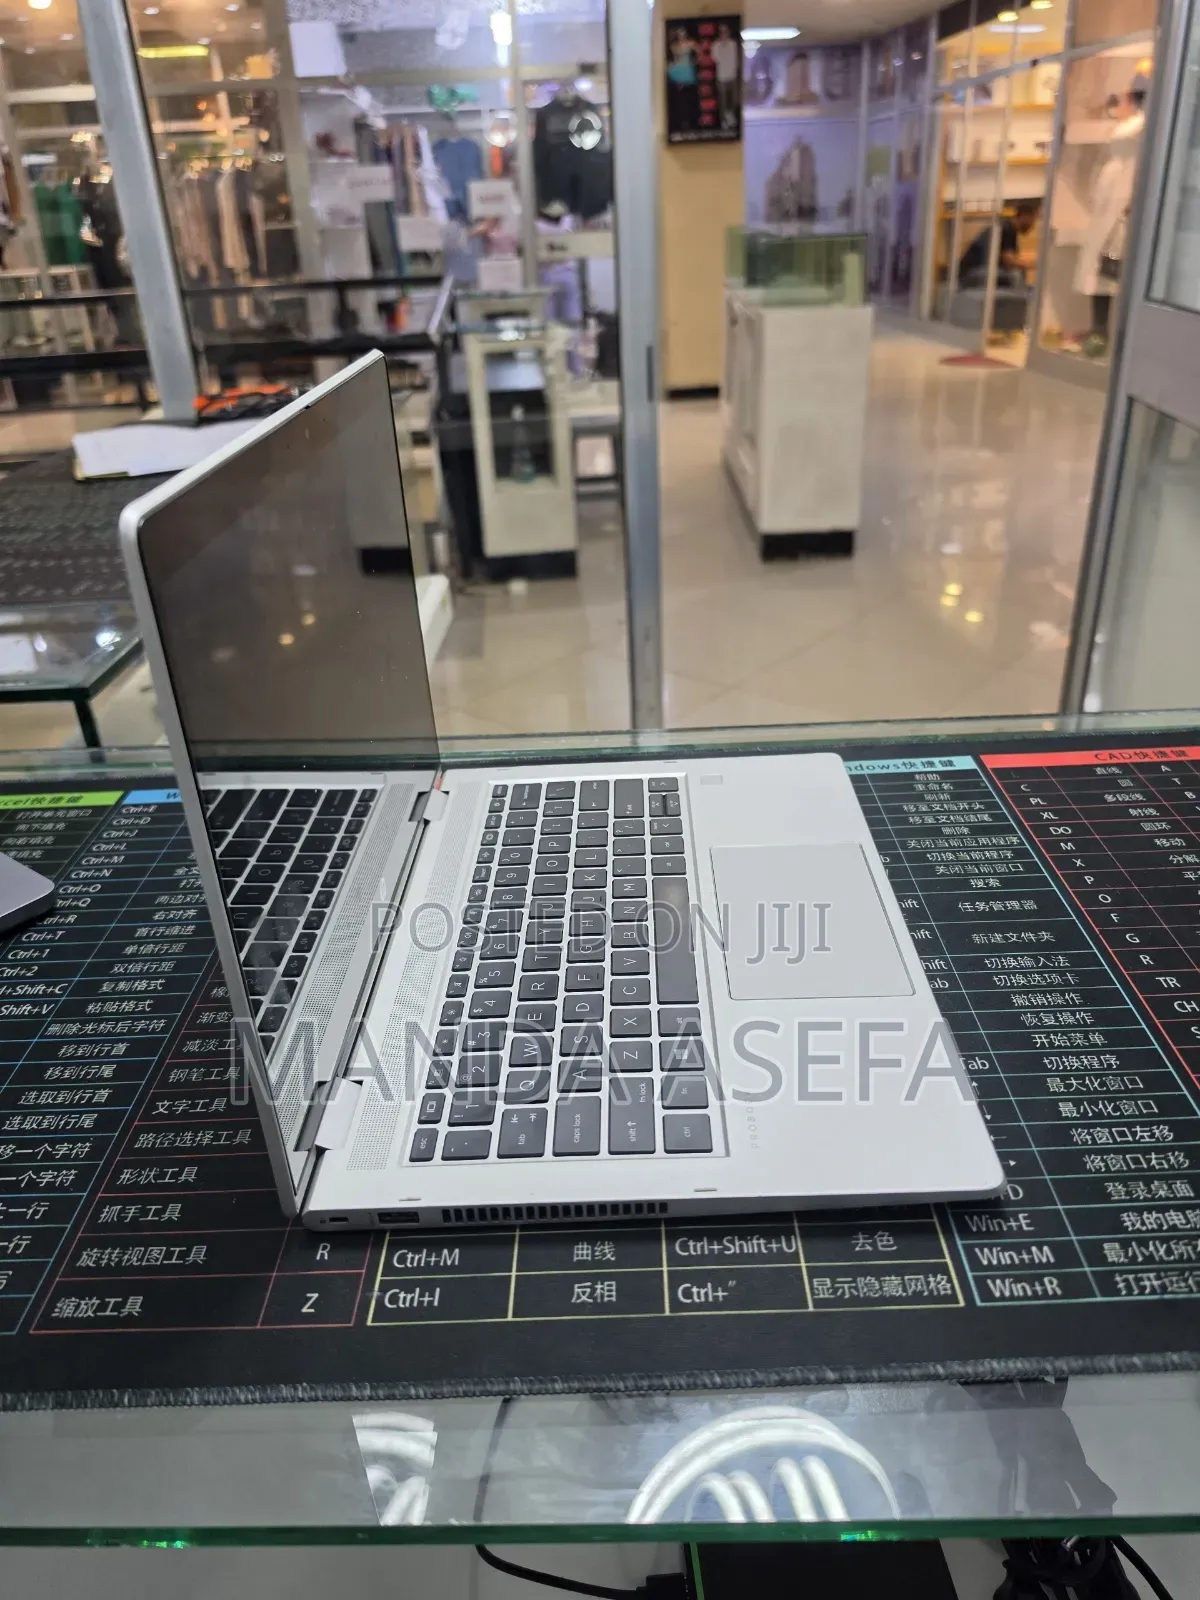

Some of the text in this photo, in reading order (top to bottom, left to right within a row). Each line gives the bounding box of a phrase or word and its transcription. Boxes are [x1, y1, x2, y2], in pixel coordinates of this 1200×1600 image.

[1094, 750, 1189, 761] CAD快捷键
[1160, 765, 1171, 773] A
[1171, 777, 1182, 786] T
[1020, 784, 1031, 792] C
[1029, 797, 1047, 806] PL
[1103, 793, 1146, 803] 多段线
[1184, 791, 1196, 800] B
[903, 801, 985, 812] 移至文档开头
[1040, 811, 1059, 820] XL
[112, 817, 151, 827] Ctrl+D
[1140, 821, 1171, 832] 圆环
[102, 830, 139, 840] Ctrl+J
[1049, 826, 1072, 835] DO
[92, 843, 127, 853] Ctrl+L
[906, 836, 1020, 849] 关闭当前应用程序
[1060, 842, 1076, 851] M
[1154, 837, 1187, 848] 移动
[81, 855, 125, 866] Ctrl+M
[926, 850, 1014, 862] 切换当前程序
[1072, 857, 1085, 867] X
[546, 860, 558, 868] O
[935, 863, 1024, 875] 关闭当前窗口
[71, 869, 113, 880] Ctrl+N
[584, 873, 596, 881] K
[1083, 875, 1094, 885] P
[623, 883, 636, 891] M
[969, 877, 1002, 888] 搜索
[59, 884, 101, 895] Ctrl+O
[1098, 892, 1111, 903] O
[623, 906, 636, 914] N
[958, 899, 1038, 913] 任务管理器
[37, 915, 78, 926] trl+R
[153, 910, 198, 921] 右对齐
[1110, 913, 1121, 924] F
[582, 920, 594, 928] H
[22, 931, 66, 943] Ctrl+T
[135, 926, 196, 937] 首行缩进
[623, 931, 636, 939] B
[971, 931, 1056, 945] 新建文件夹
[1125, 933, 1141, 945] G
[8, 949, 50, 961] Ctrl+1
[123, 943, 186, 955] 单倍行距
[580, 944, 593, 954] G
[534, 954, 549, 962] T
[624, 957, 637, 966] V
[984, 955, 1071, 969] 切换输入法
[1139, 954, 1155, 967] R
[110, 961, 177, 974] 双倍行距
[488, 970, 501, 978] 5
[577, 973, 592, 981] F
[992, 972, 1080, 986] 切换选项卡
[99, 979, 166, 993] 复制格式
[531, 981, 545, 991] R
[1154, 976, 1182, 989] TR
[211, 986, 231, 999] 橡
[622, 986, 637, 995] C
[484, 999, 498, 1007] 4
[1010, 992, 1083, 1007] 撤销操作
[86, 1000, 154, 1014] 粘贴格式
[575, 1002, 590, 1012] D
[1173, 1000, 1199, 1014] CH
[198, 1010, 236, 1024] 渐变
[527, 1012, 542, 1022] E
[624, 1016, 638, 1026] X
[1020, 1011, 1095, 1027] 恢复操作
[45, 1020, 167, 1036] 删除光标后字符
[477, 1030, 491, 1039] 3
[1031, 1032, 1108, 1048] 开始菜单
[58, 1042, 130, 1057] 移到行首
[523, 1043, 539, 1058] W
[623, 1050, 638, 1060] Z
[1043, 1053, 1120, 1070] 切换程序
[44, 1064, 117, 1080] 移到行尾
[169, 1066, 241, 1083] 钢笔工具
[472, 1065, 487, 1073] 2
[571, 1068, 588, 1080] A
[519, 1080, 535, 1092] Q
[639, 1082, 647, 1094] lock
[1046, 1075, 1144, 1093] 最大化窗口
[18, 1089, 113, 1105] 选取到行首
[152, 1097, 228, 1116] 文字工具
[1058, 1100, 1159, 1118] 最小化窗口
[2, 1113, 98, 1130] 选取到行尾
[573, 1113, 581, 1143] caps lock
[134, 1129, 252, 1149] 路径选择工具
[629, 1128, 637, 1142] shift
[1070, 1124, 1174, 1145] 将窗口左移
[419, 1137, 428, 1149] esc
[1082, 1150, 1190, 1172] 将窗口右移
[116, 1166, 199, 1185] 形状工具
[1103, 1179, 1195, 1201] 登录桌面
[98, 1204, 182, 1224] 抓手工具
[965, 1212, 1035, 1233] Win+E
[675, 1234, 798, 1257] Ctrl+Shift+U
[852, 1230, 897, 1253] 去色
[75, 1245, 208, 1268] 旋转视图工具
[316, 1243, 331, 1261] R
[393, 1248, 461, 1268] Ctrl+M
[573, 1241, 617, 1263] 曲线
[974, 1245, 1055, 1266] Win+M
[571, 1281, 618, 1303] 反相
[813, 1273, 952, 1300] 显示隐藏网格
[987, 1276, 1062, 1298] Win+R
[301, 1293, 319, 1313] Z
[384, 1287, 441, 1308] Ctrl+I
[50, 1295, 144, 1319] 缩放工具
